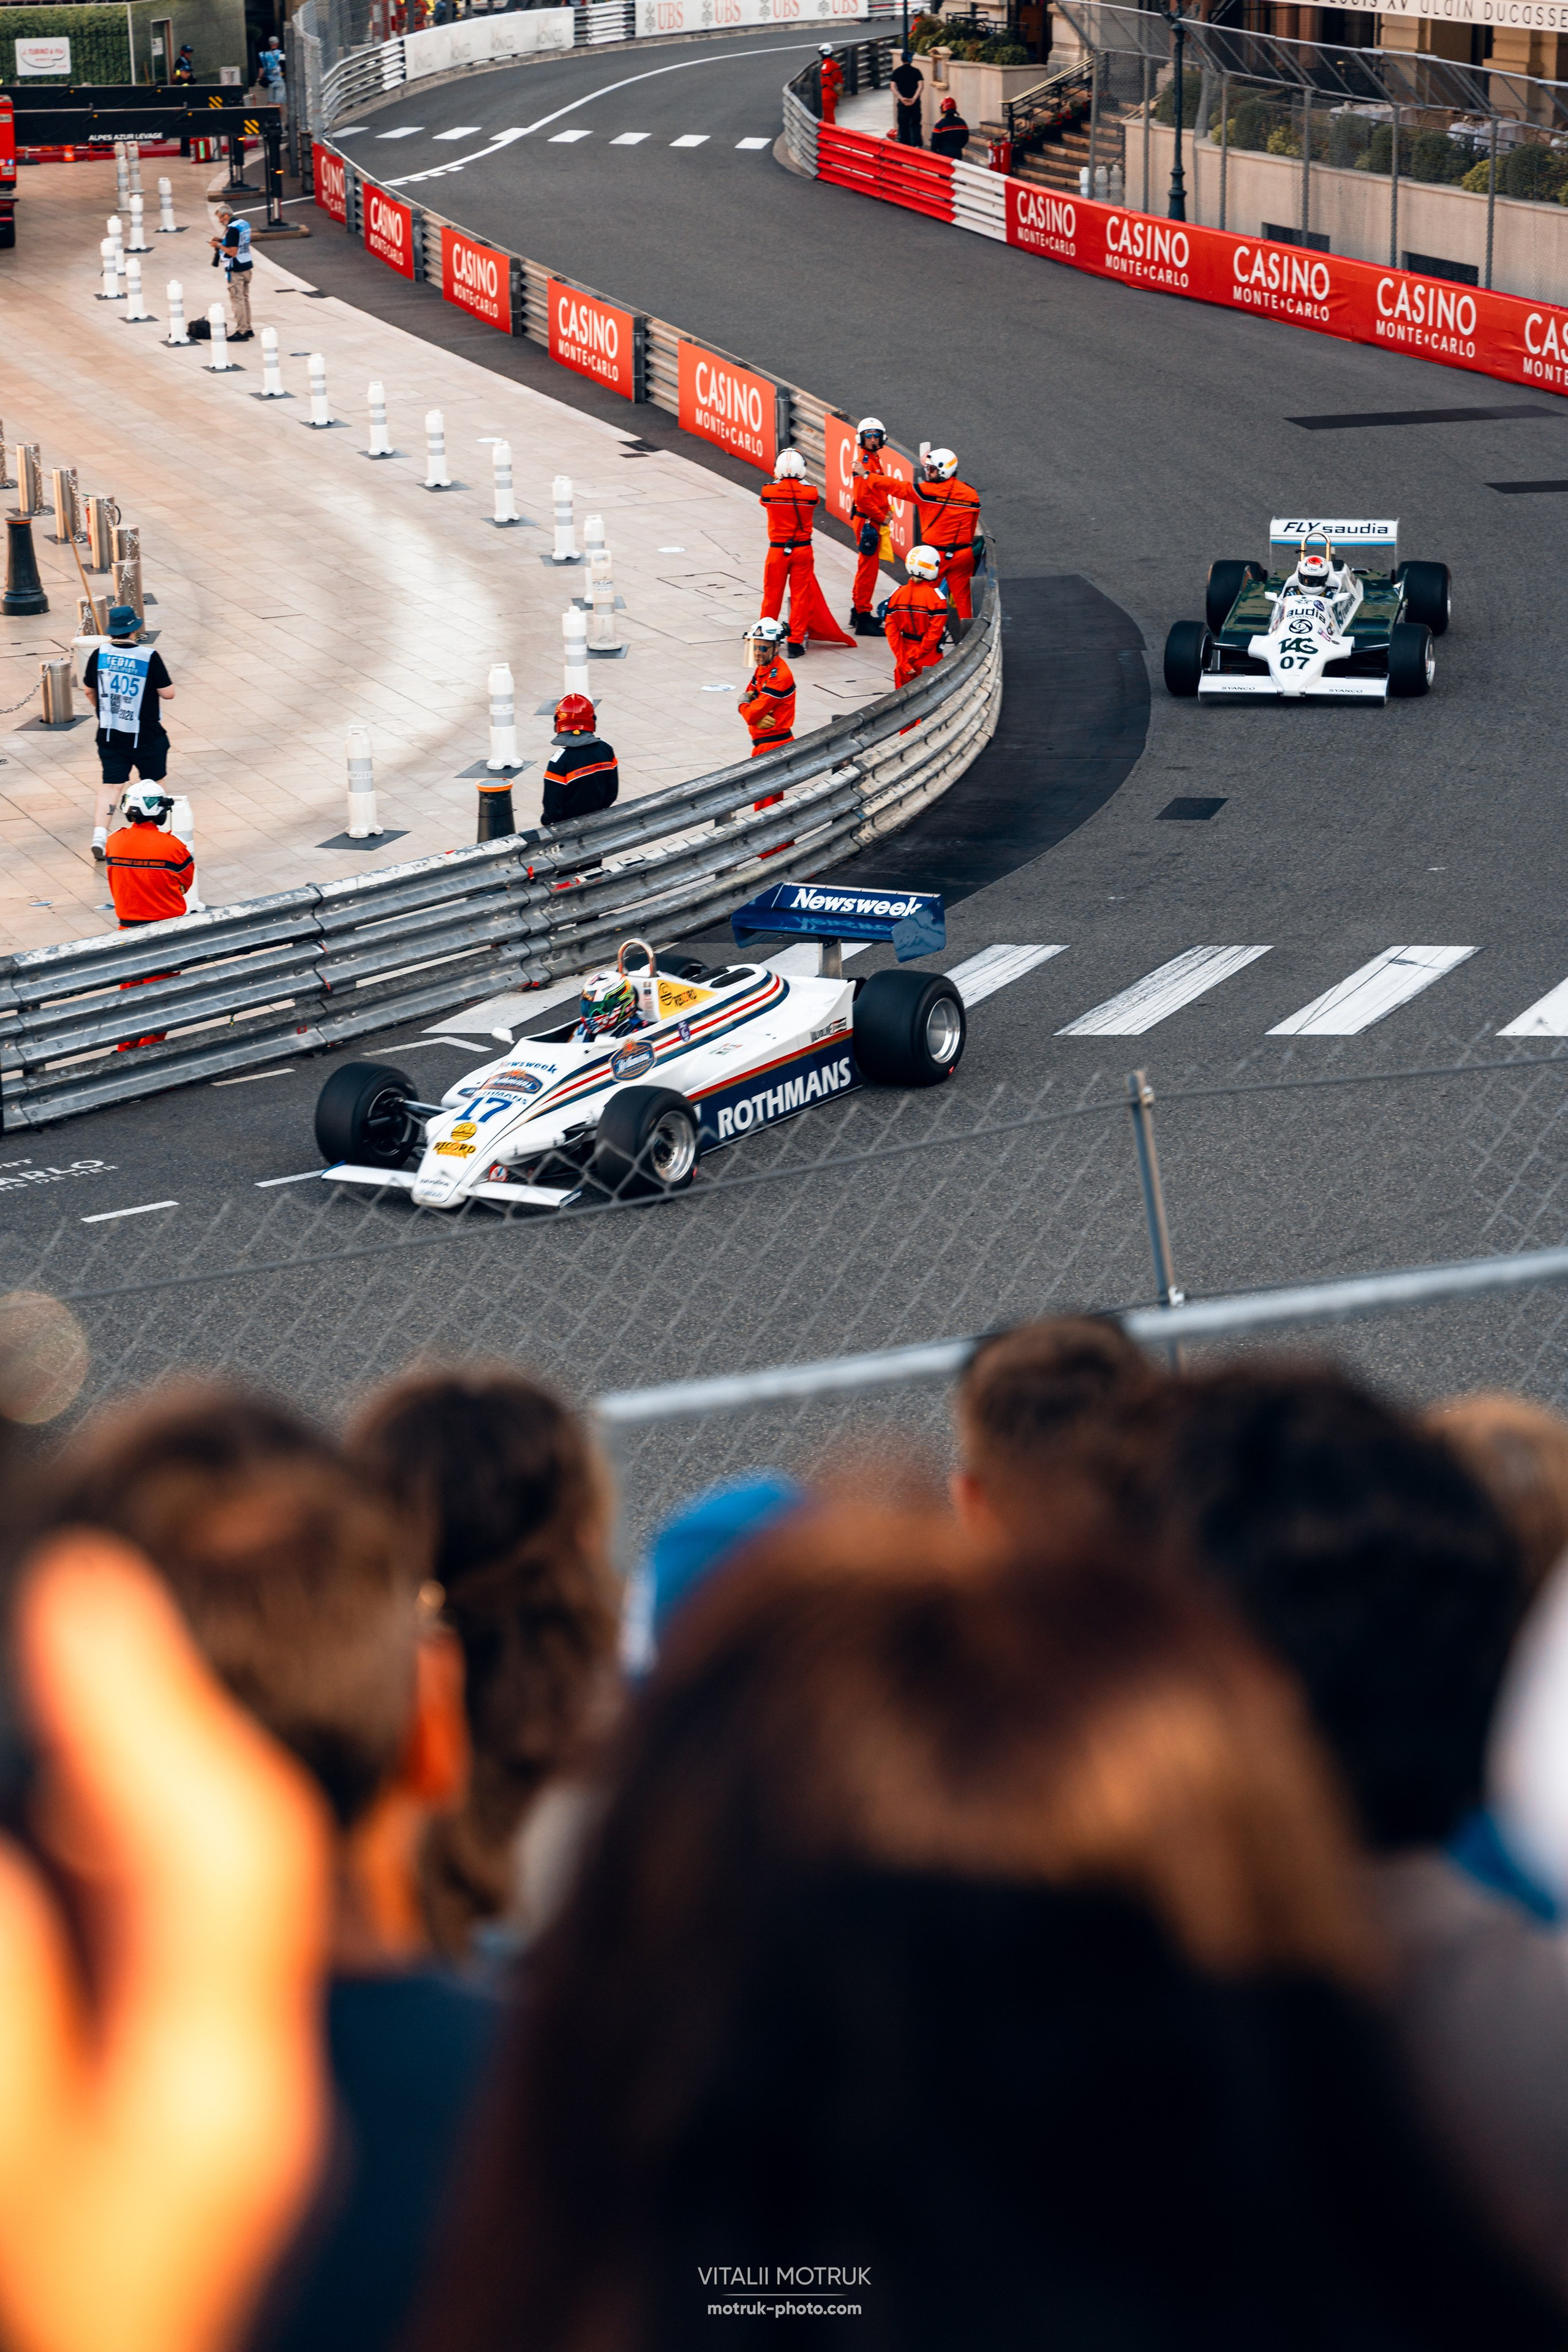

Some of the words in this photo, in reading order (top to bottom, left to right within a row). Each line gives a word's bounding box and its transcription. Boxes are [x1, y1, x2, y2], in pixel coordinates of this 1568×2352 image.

[657, 2, 684, 29] UBS
[715, 0, 741, 23] UBS
[773, 0, 799, 18] UBS
[1484, 2, 1568, 28] DUCASSE
[371, 197, 402, 247] CASINO
[1017, 191, 1076, 238] CASINO
[1106, 216, 1189, 268] CASINO
[453, 243, 497, 297] CASINO
[1234, 246, 1330, 300] CASINO
[1377, 277, 1476, 335] CASINO
[558, 296, 618, 359] CASINO
[695, 362, 762, 432] CASINO
[1283, 522, 1321, 532] FLY
[1323, 523, 1388, 533] saudia
[1280, 656, 1310, 669] 07
[110, 674, 140, 697] 405
[790, 888, 922, 917] Newsweek
[454, 1097, 513, 1123] 17
[717, 1057, 852, 1139] ROTHMANS
[433, 1141, 476, 1155] RECORD
[0, 1158, 32, 1169] RT
[71, 1166, 119, 1177] MER
